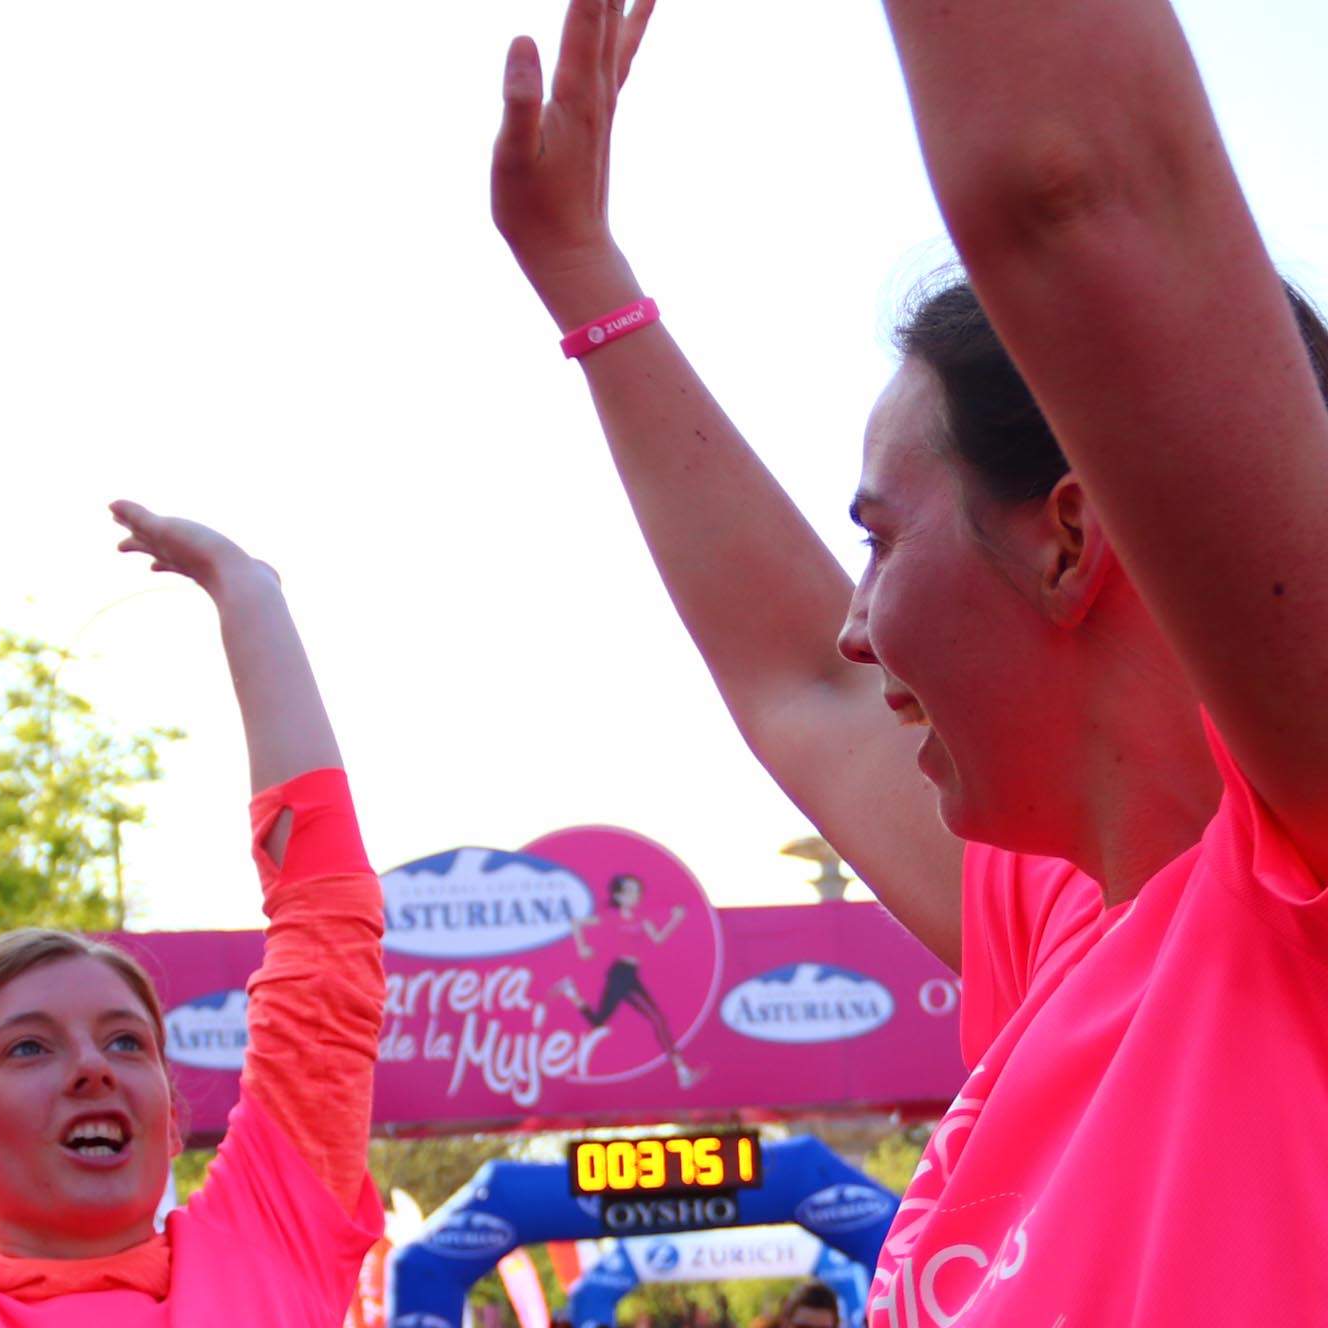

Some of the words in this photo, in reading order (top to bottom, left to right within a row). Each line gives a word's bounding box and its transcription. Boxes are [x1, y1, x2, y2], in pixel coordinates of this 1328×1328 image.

[605, 310, 644, 334] ZURICH
[384, 966, 533, 1015] arrera
[734, 996, 881, 1024] ASTURIANA
[424, 1016, 452, 1060] la
[446, 1004, 611, 1107] Mujer
[605, 1197, 736, 1230] OYSHO
[690, 1244, 795, 1268] ZURICH
